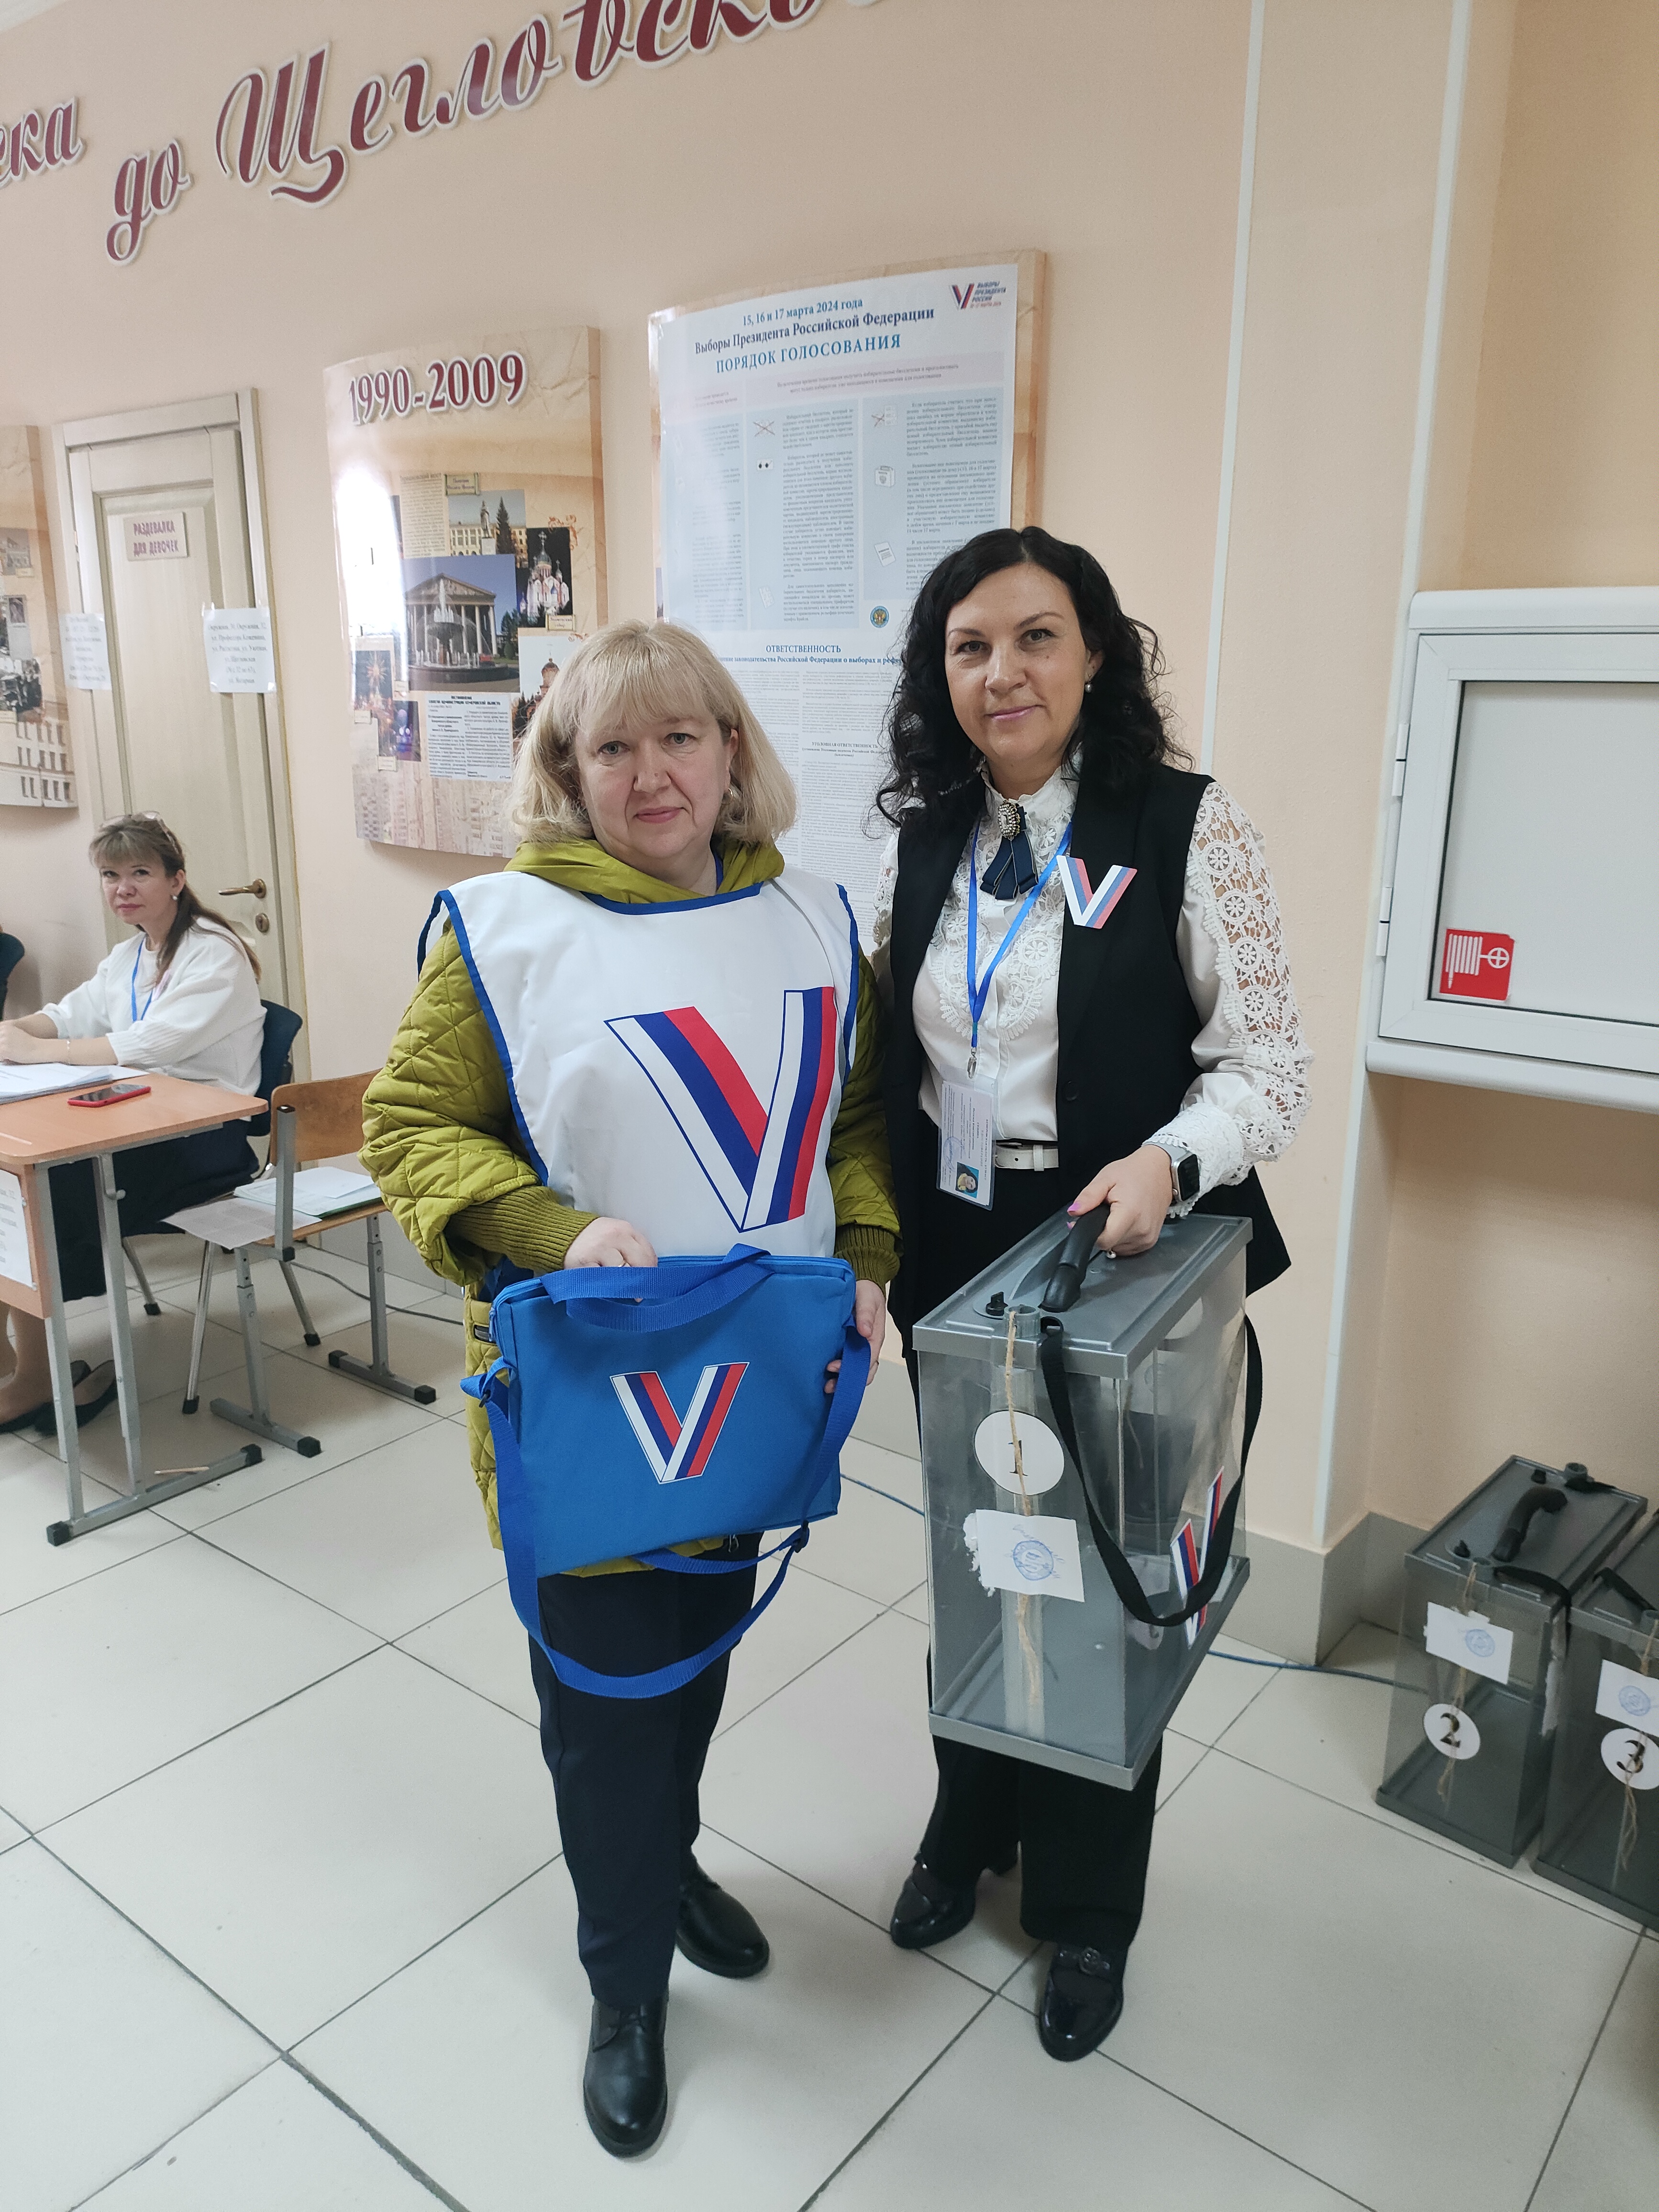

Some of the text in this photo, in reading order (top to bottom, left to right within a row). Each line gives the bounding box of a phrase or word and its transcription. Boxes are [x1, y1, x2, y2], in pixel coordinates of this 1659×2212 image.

[106, 139, 192, 265] до
[743, 299, 863, 327] 15, 16 и 17 марта 2024 года
[695, 309, 934, 354] Выборы Президента Российской Федерации
[716, 334, 901, 374] ПОРЯДОК ГОЛОСОВАНИЯ
[349, 352, 526, 426] 1990-2009
[133, 520, 176, 537] РАЗДЕВАЛКА
[133, 539, 179, 557] ДЛЯ ДЕВОЧЕК
[766, 645, 841, 653] ОТВЕТСТВЕННОСТЬ
[1008, 1439, 1028, 1477] 1
[1439, 1713, 1461, 1748] 2
[1616, 1739, 1646, 1774] 3
